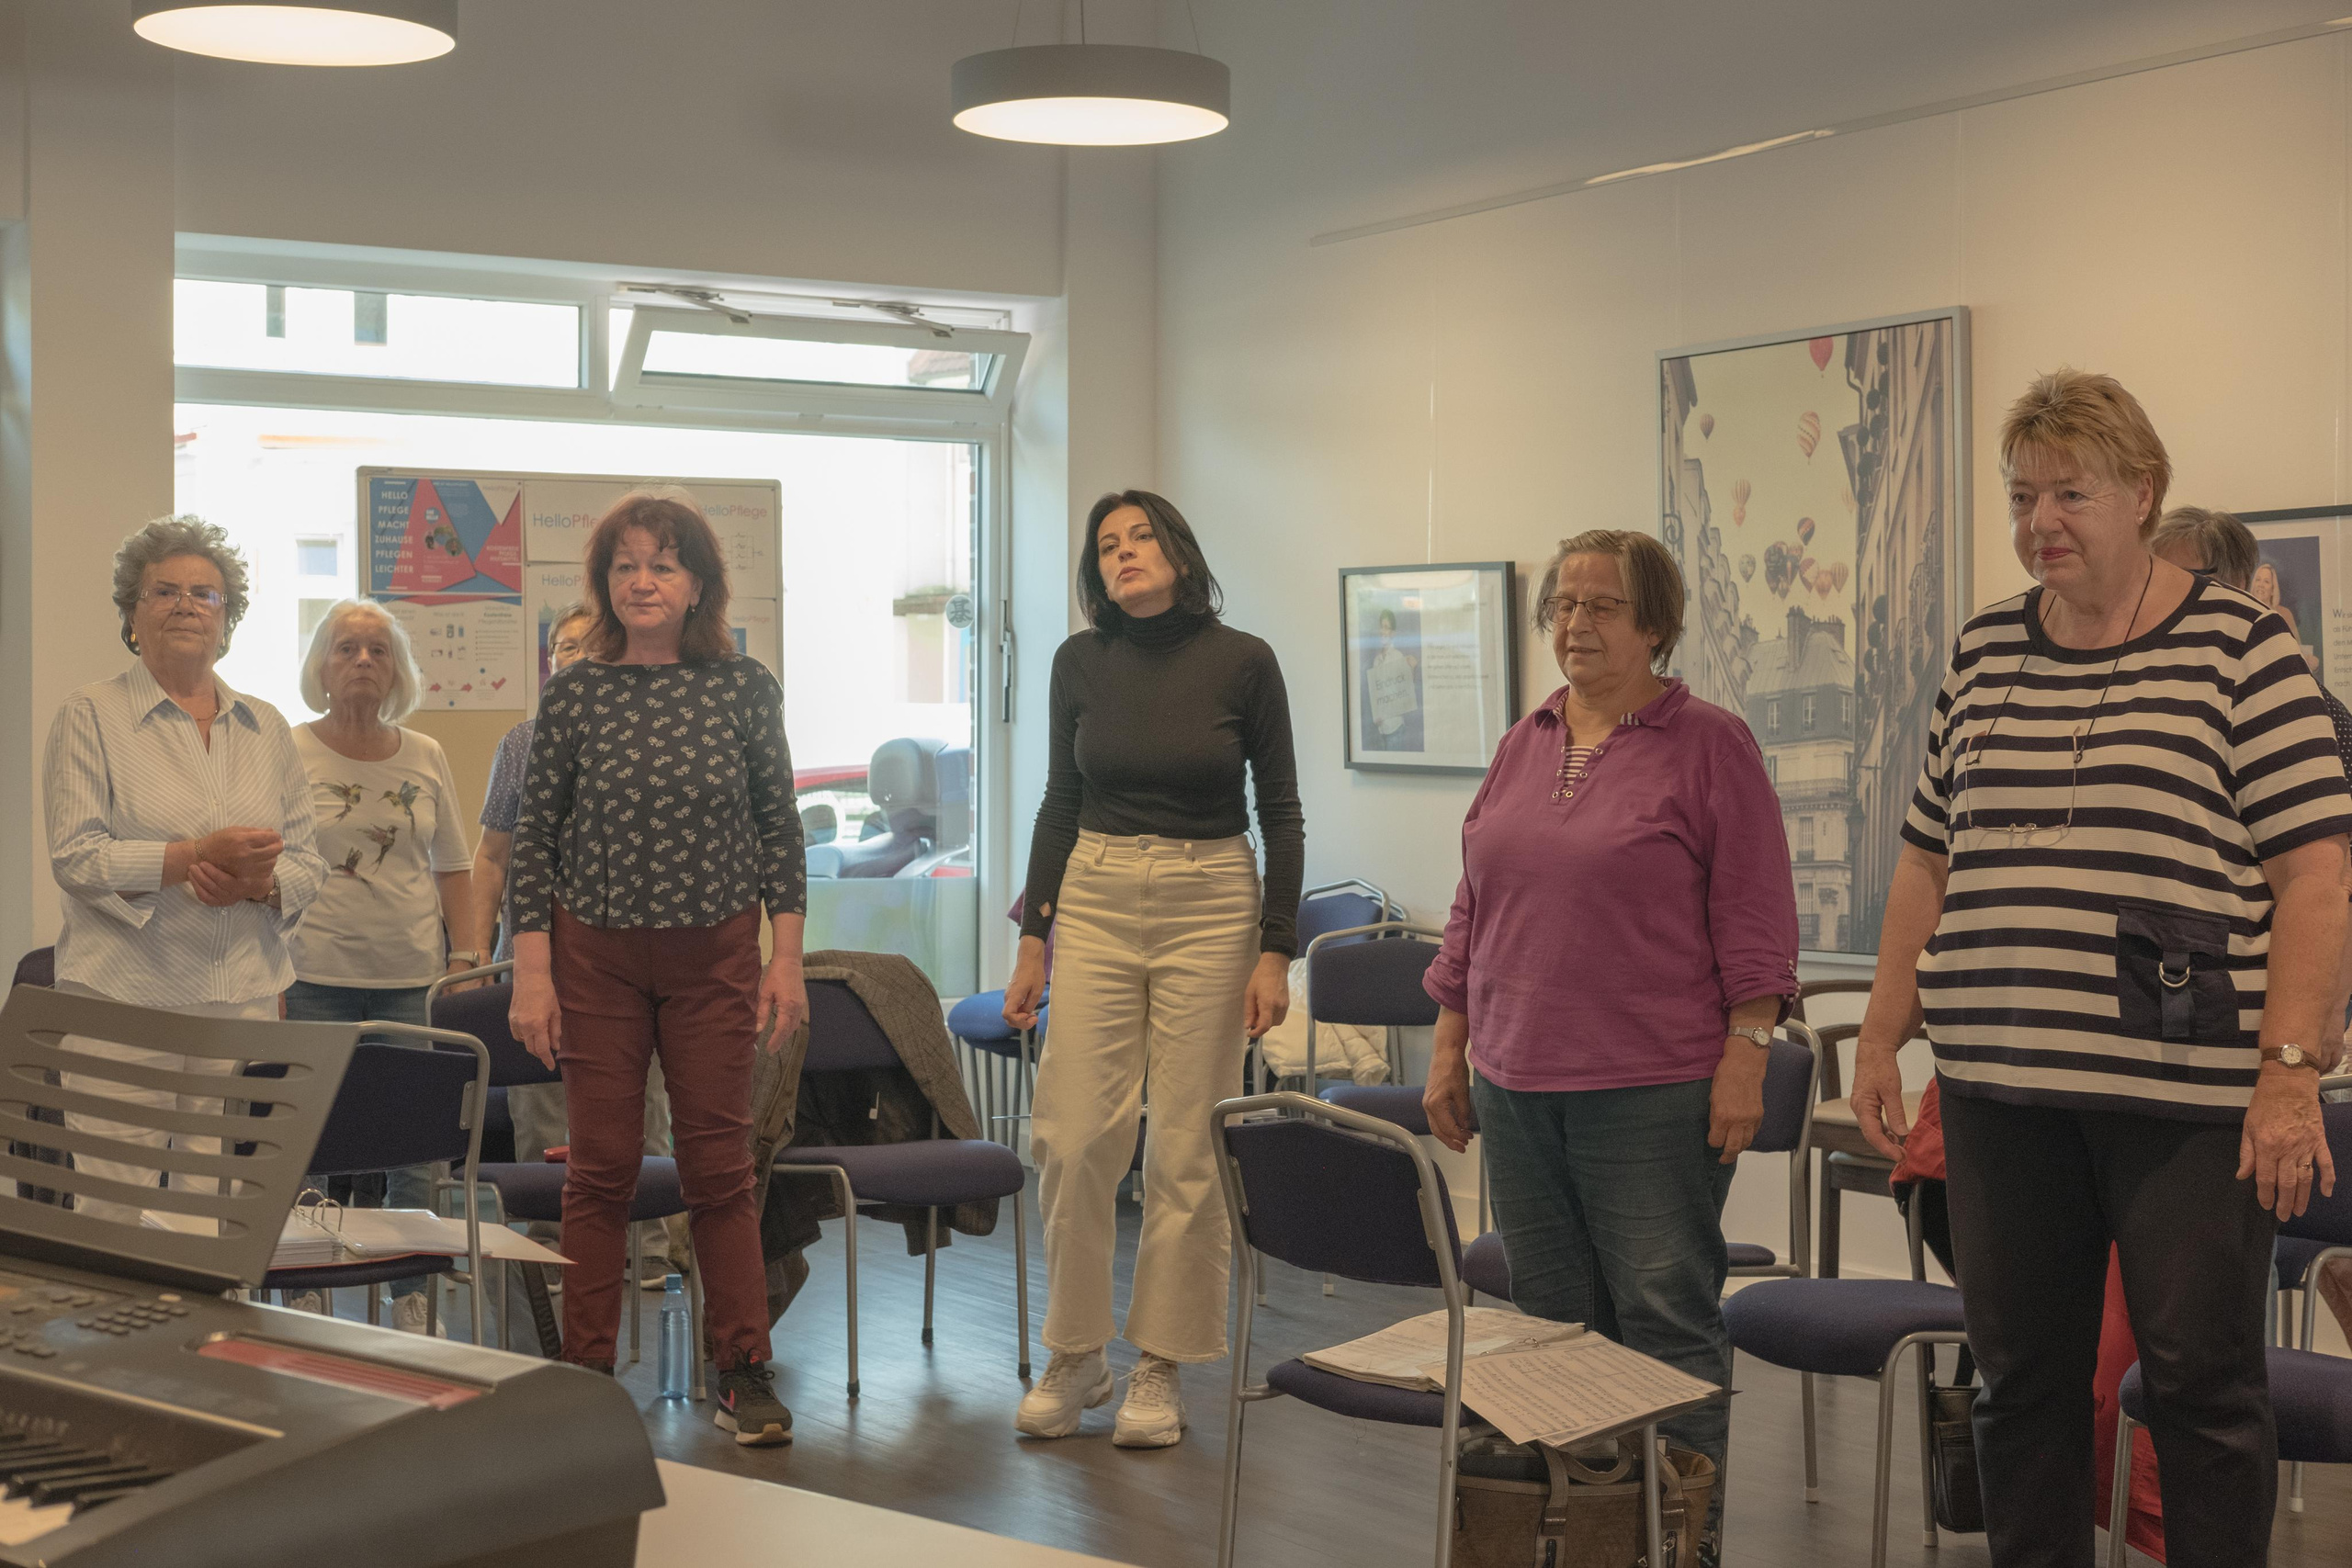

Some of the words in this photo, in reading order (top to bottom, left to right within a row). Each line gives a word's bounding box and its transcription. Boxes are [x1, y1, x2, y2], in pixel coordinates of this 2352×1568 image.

[381, 491, 408, 500] HELLO
[378, 506, 409, 514] PFLEGE
[533, 513, 598, 528] HelloPfle
[378, 521, 410, 529] MACHT
[375, 536, 413, 544] ZUHAUSE
[375, 550, 413, 558] PFLEGEN
[375, 565, 414, 573] LEICHTER
[542, 574, 583, 589] HelloP
